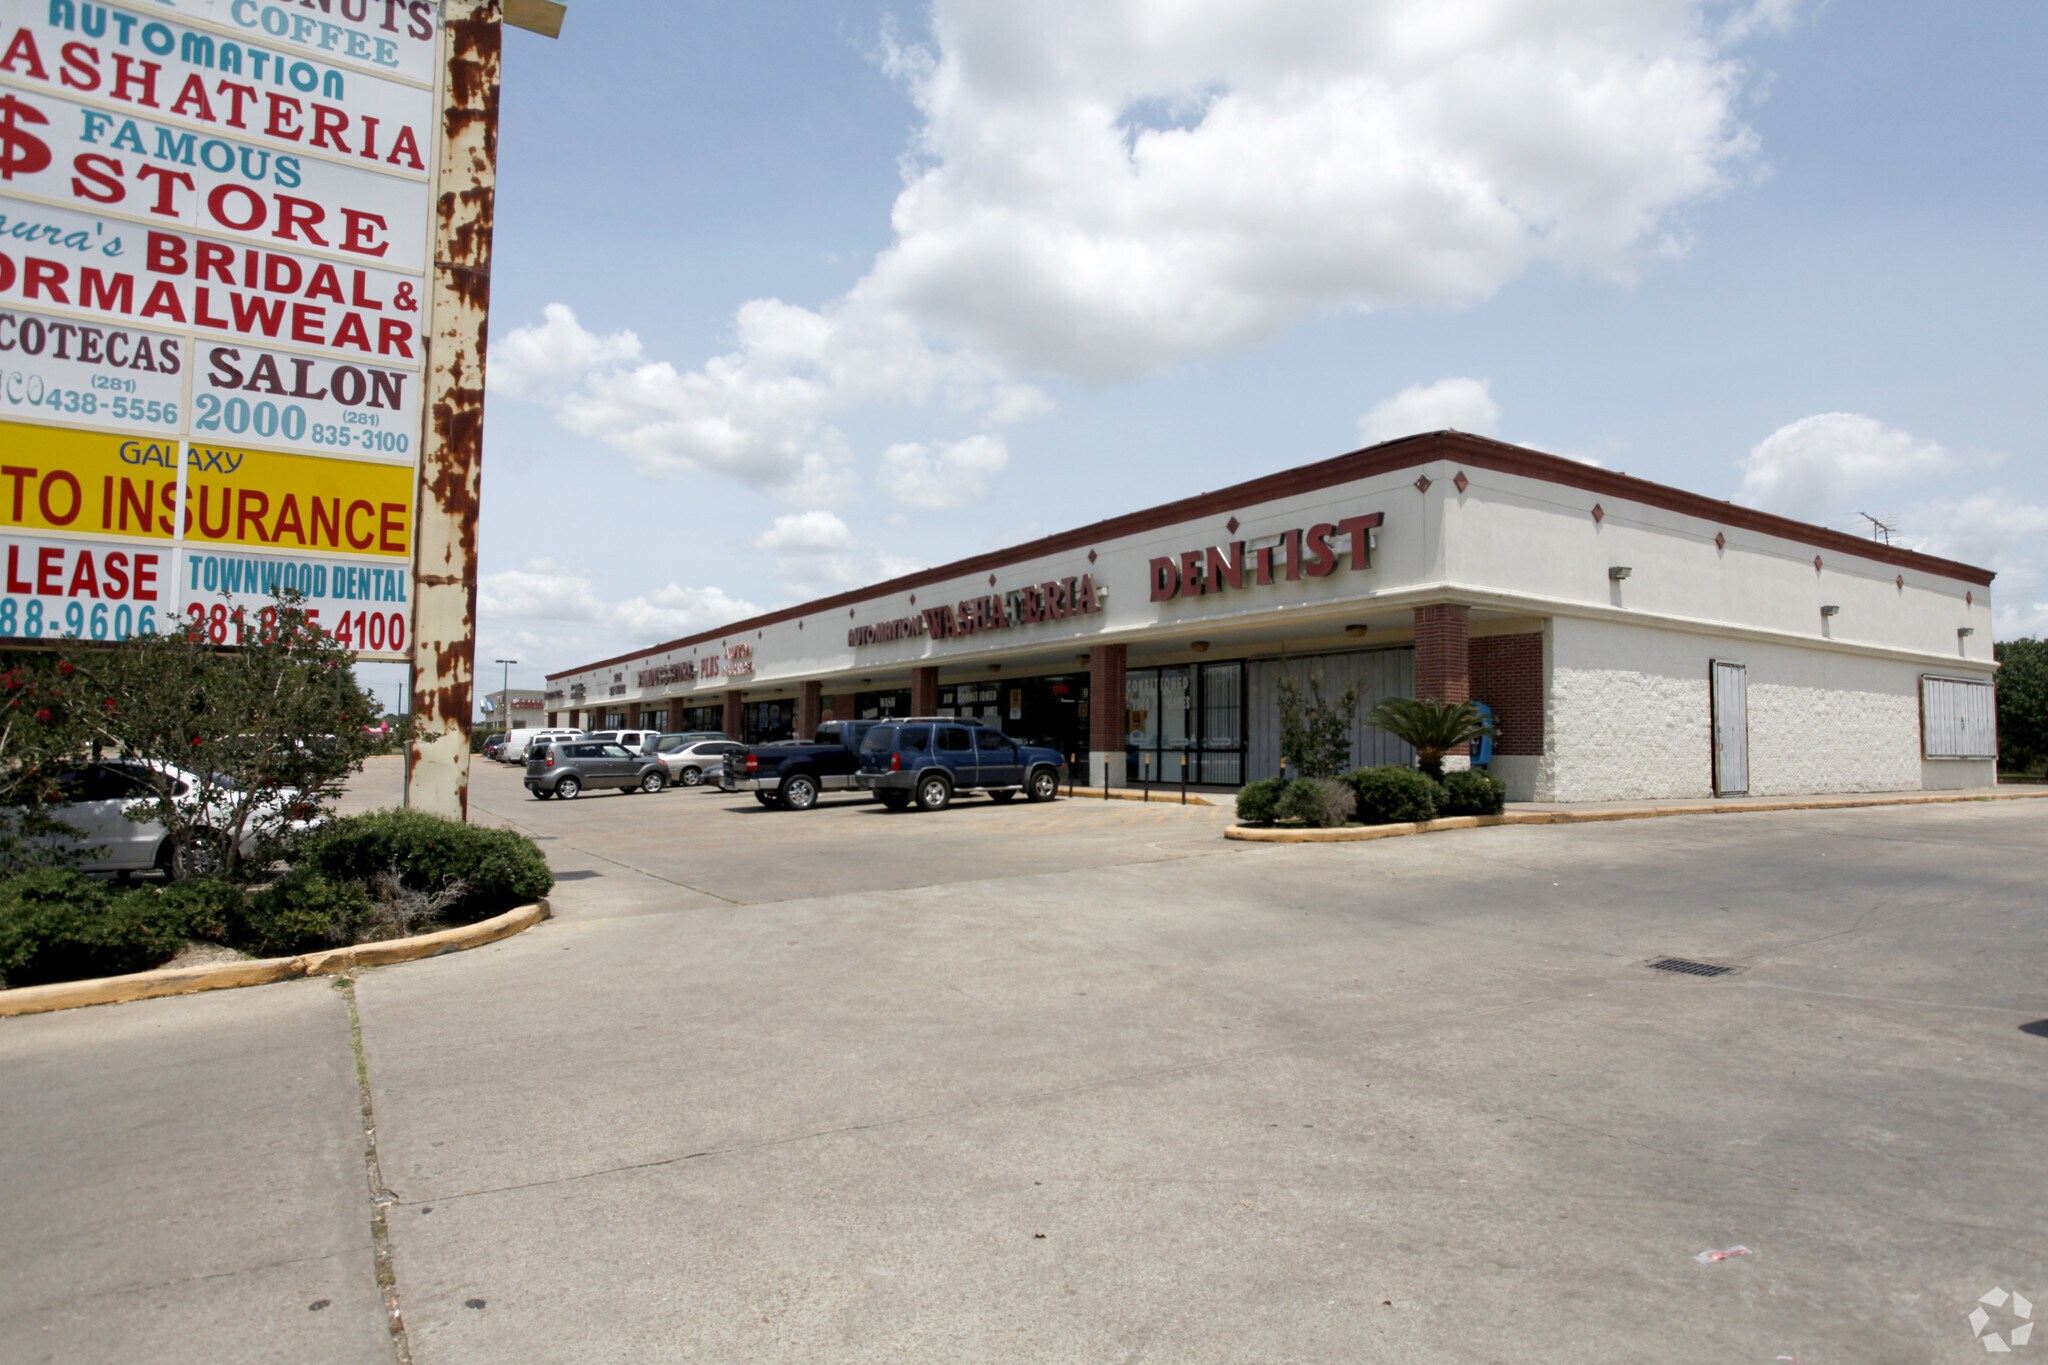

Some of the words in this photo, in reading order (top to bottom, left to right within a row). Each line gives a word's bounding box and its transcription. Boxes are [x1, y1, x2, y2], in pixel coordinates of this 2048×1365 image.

[48, 0, 345, 101] AUTOMATION
[231, 0, 400, 68] COFFEE
[0, 22, 425, 170] ASHATERIA
[80, 109, 302, 189] FAMOUS
[71, 153, 389, 257] STORE
[146, 231, 382, 311] BRIDAL
[393, 281, 418, 312] &
[46, 388, 178, 424] 438-5556
[91, 374, 136, 394] (281)
[207, 346, 407, 411] SALON
[195, 393, 306, 440] 2000
[311, 423, 409, 453] 835-3100
[342, 410, 380, 428] (281)
[119, 441, 243, 474] GALAXY
[102, 475, 407, 554] INSURANCE
[7, 545, 158, 601] LEASE
[189, 555, 327, 599] TOWNWOOD
[331, 566, 407, 603] DENTAL
[1149, 511, 1384, 603] DENTIST
[187, 602, 405, 651] 281-85-4100
[848, 615, 923, 647] AUTOMATION
[922, 573, 1101, 640] WASHATERIA
